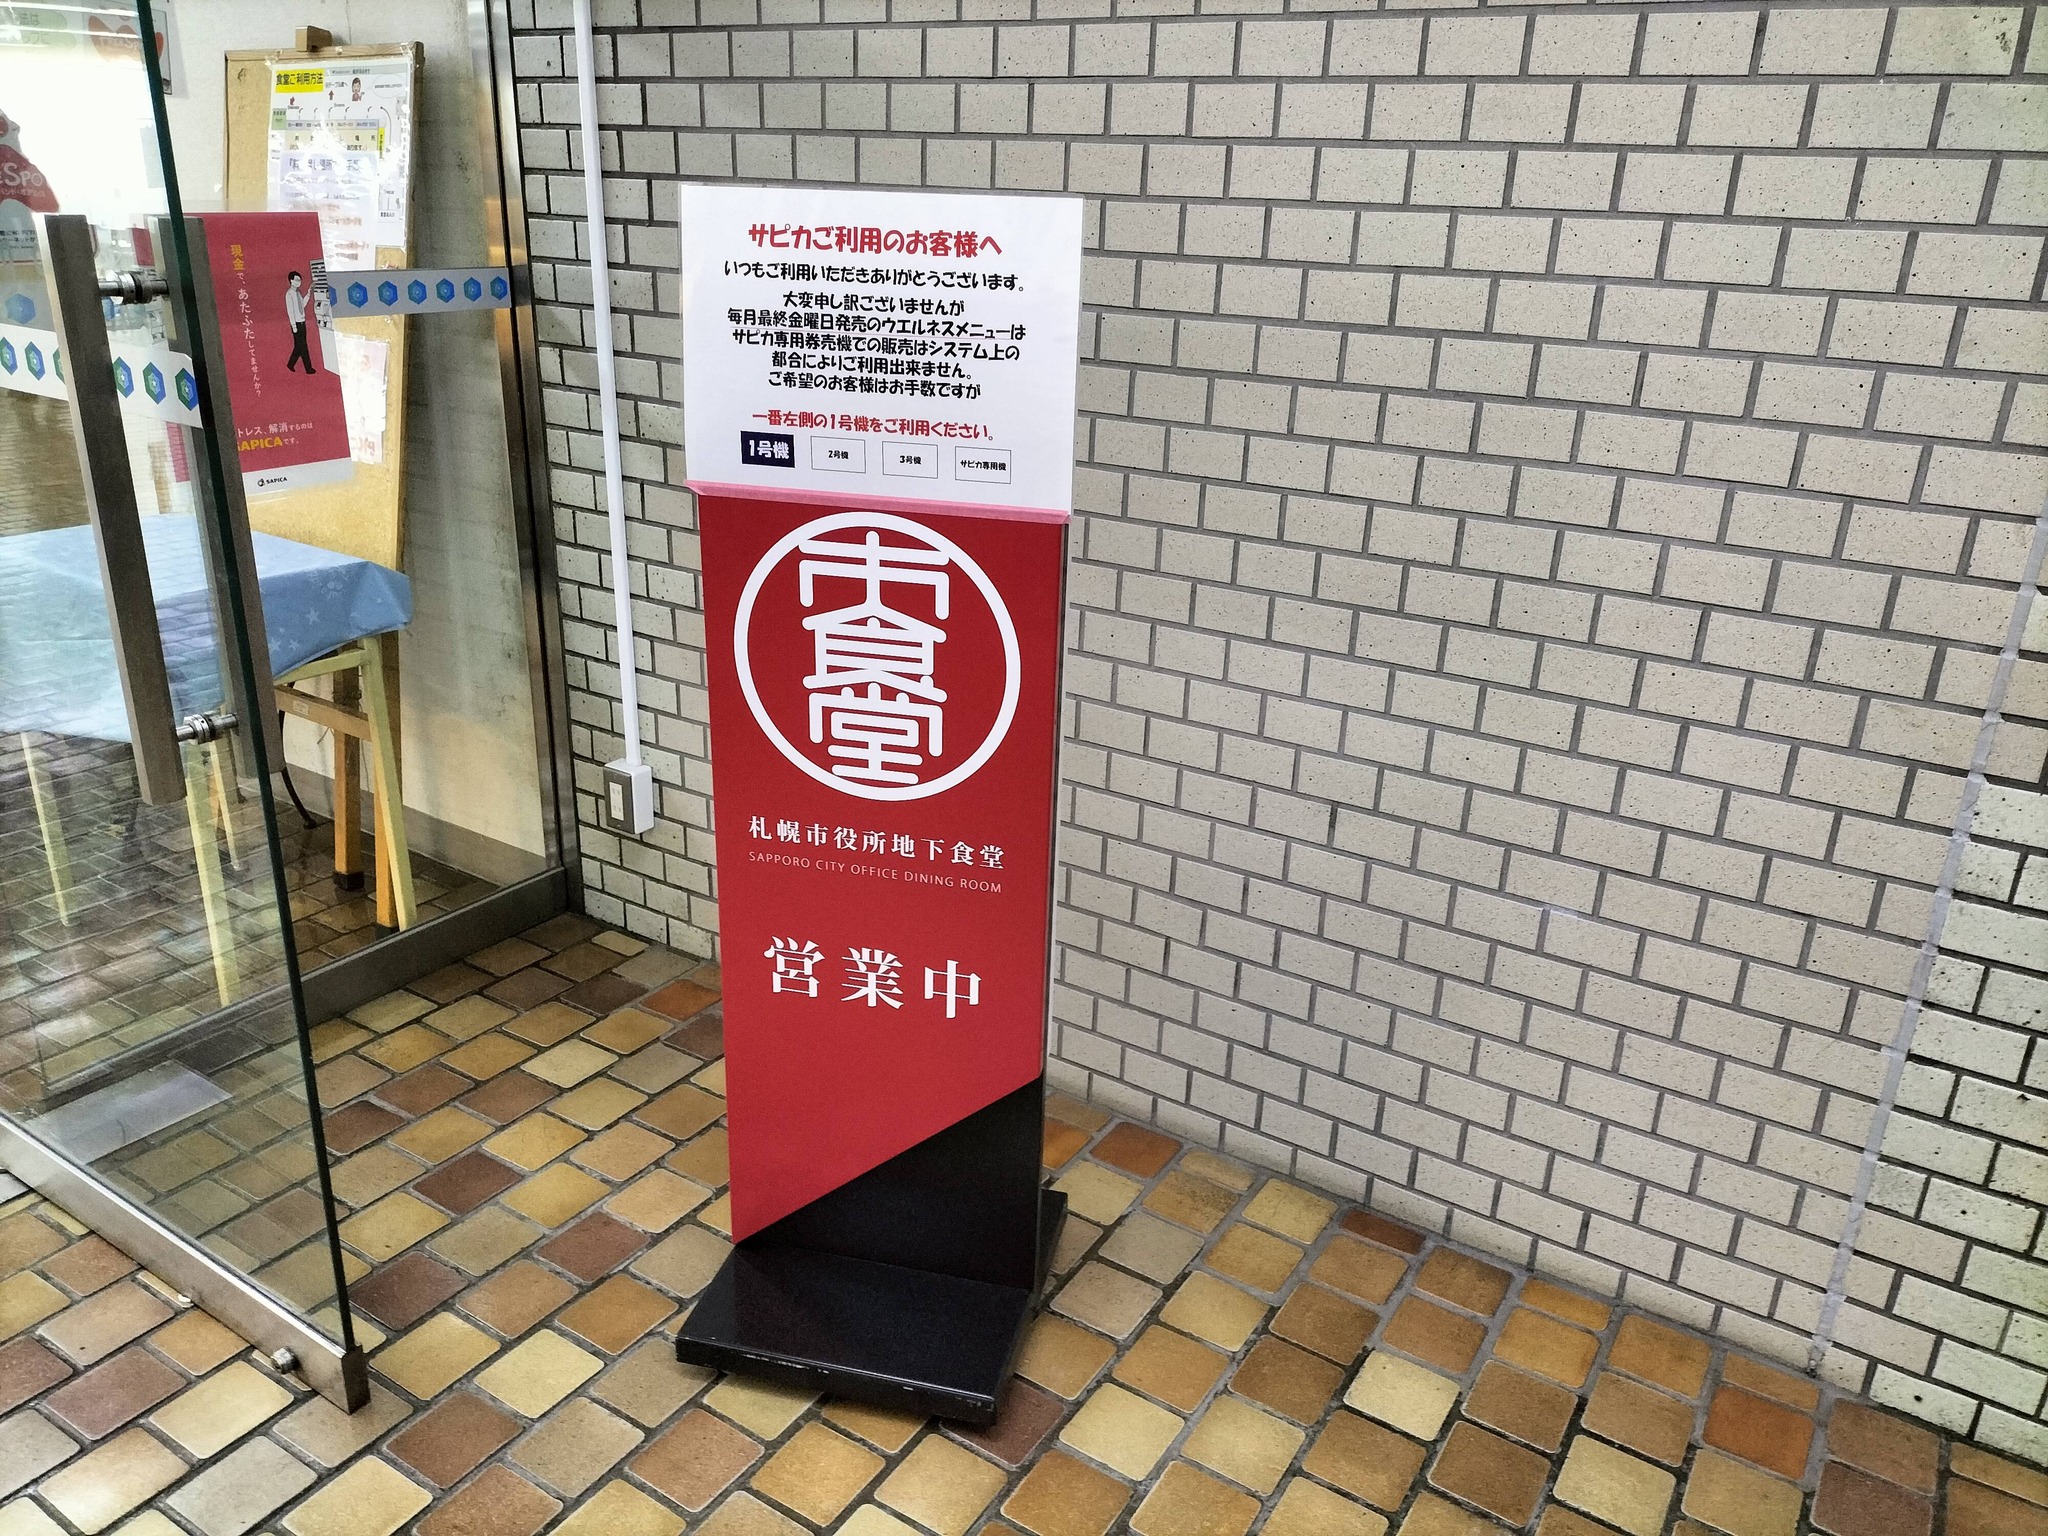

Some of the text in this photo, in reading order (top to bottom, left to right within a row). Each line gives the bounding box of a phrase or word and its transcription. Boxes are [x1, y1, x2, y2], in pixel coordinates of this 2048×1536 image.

[276, 72, 324, 86] 食堂ご利用方法
[748, 223, 1003, 258] サピカご利用のお客様へ
[724, 260, 1025, 292] いつもご利用いただきありがとうございます。
[782, 291, 965, 317] 大変申し訳ございませんが
[727, 308, 1026, 340] 毎月最終金曜日発売のウエルネスメニューは
[732, 330, 1020, 361] サピカ専用券売機での販売はシステム上の
[772, 352, 974, 380] 都合によりご利用出来ません。
[768, 372, 981, 400] ご希望のお客様はお手数ですが
[752, 409, 994, 441] 一番左側の1号機をご利用ください。
[748, 439, 790, 459] 1号機
[828, 449, 849, 461] 2号機
[899, 455, 922, 466] 3号機
[960, 459, 1007, 472] サピカ専用機
[266, 476, 288, 485] SAPICA
[748, 816, 1005, 870] 札幌市役所地下食堂
[749, 851, 1002, 893] SAPPORO CITY OFFICE DINING ROOM
[763, 936, 982, 1019] 営業中
